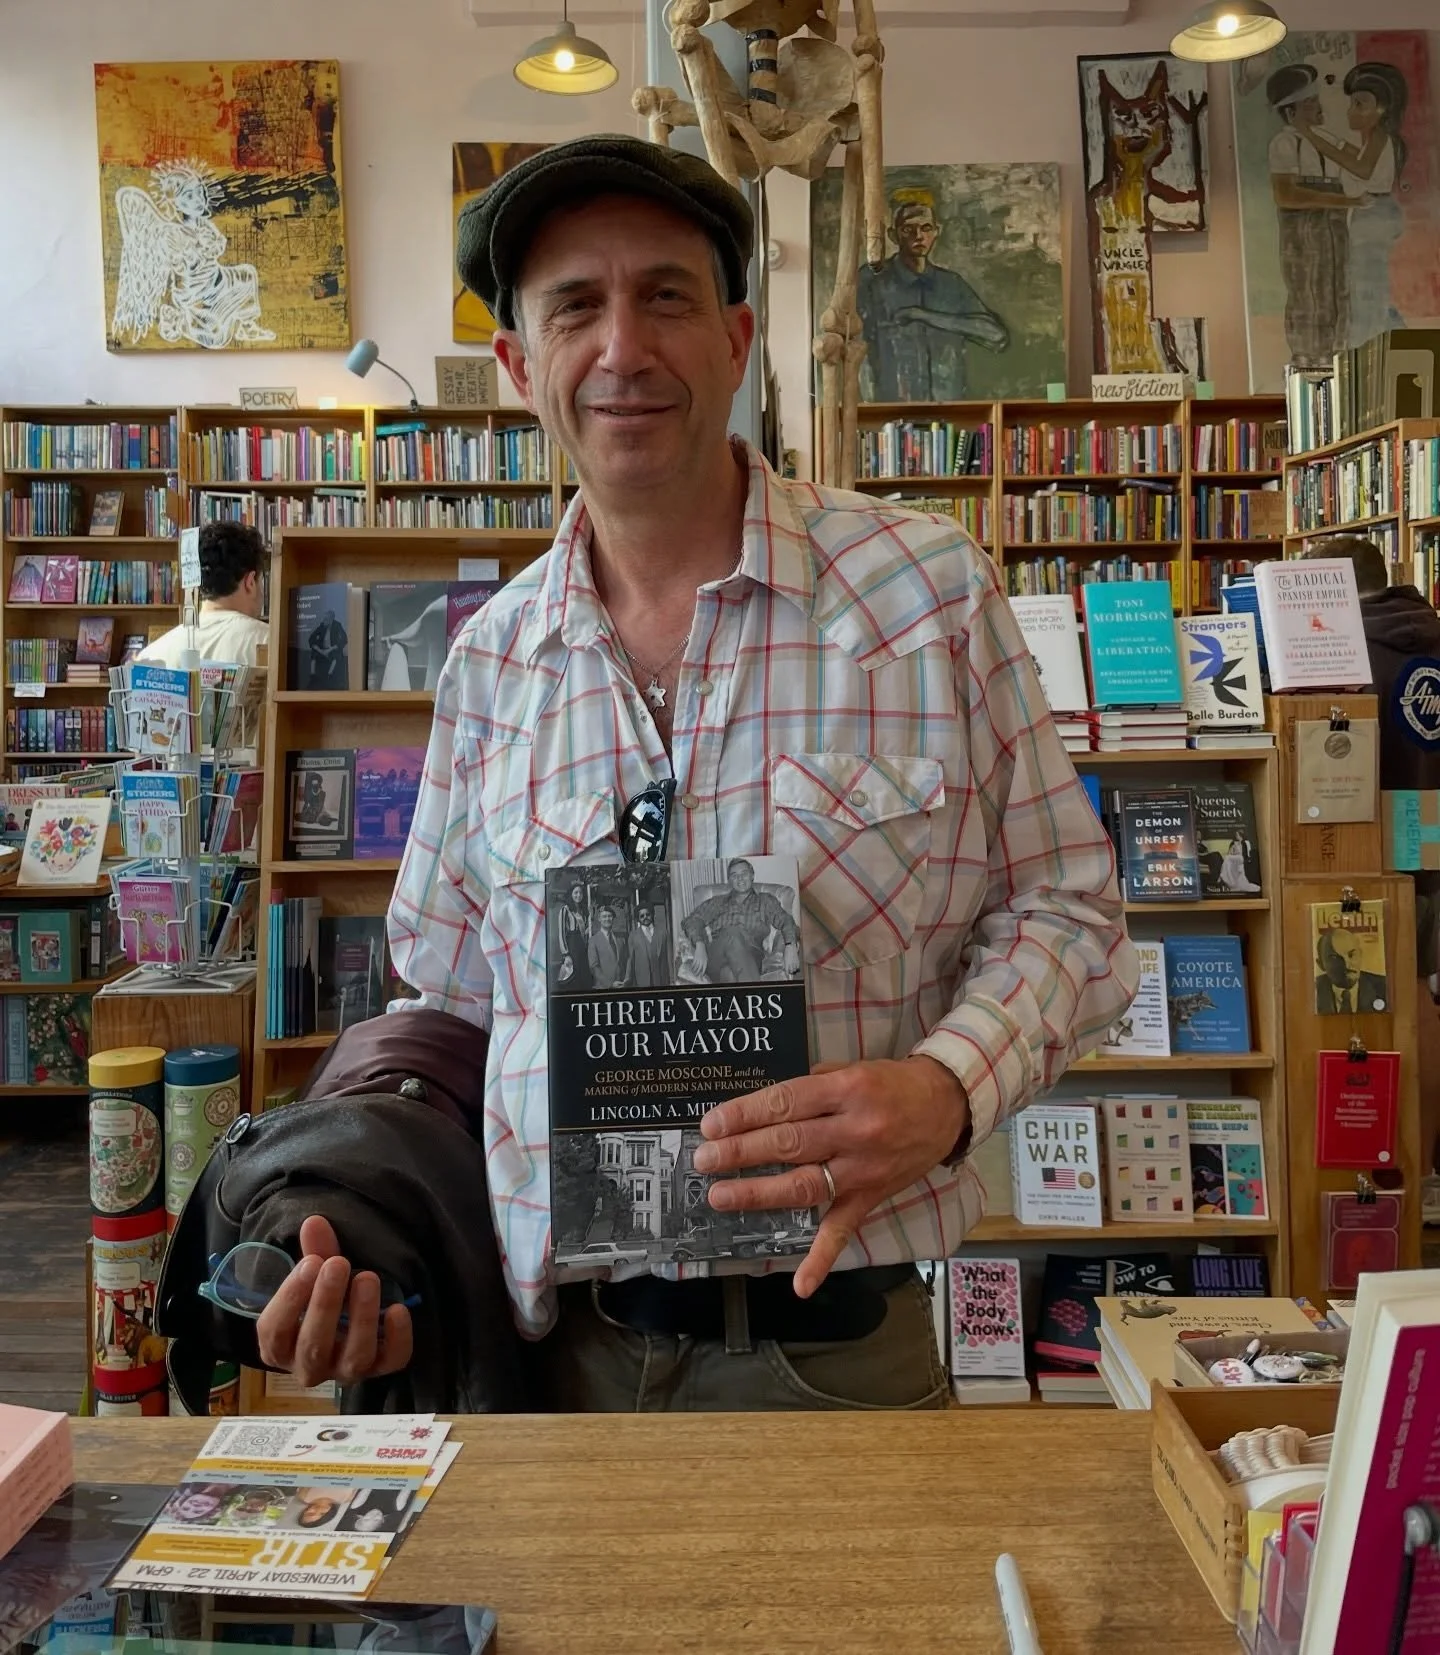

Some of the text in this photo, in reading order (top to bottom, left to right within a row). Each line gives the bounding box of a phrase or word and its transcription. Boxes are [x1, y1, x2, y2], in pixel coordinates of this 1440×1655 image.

[1104, 248, 1143, 259] UNCLE
[466, 360, 477, 404] CREATIVE
[242, 391, 296, 406] POETRY
[1294, 572, 1346, 586] RADICAL
[1278, 589, 1348, 600] SPANISH EMPIRE
[1115, 600, 1144, 608] TONI
[1094, 611, 1168, 622] MORRISON
[1181, 620, 1247, 632] Strangers
[1097, 646, 1172, 656] LIBERATION
[136, 679, 184, 692] STICKERS
[1186, 708, 1258, 720] Belle Burden
[8, 788, 44, 797] DRESS
[128, 808, 177, 817] RTHDAY!
[1200, 806, 1242, 818] Society
[1136, 818, 1182, 828] DEMON
[1136, 835, 1184, 845] UNREST
[1148, 864, 1176, 872] ERIK
[1134, 876, 1193, 888] LARSON
[1316, 908, 1378, 929] Lenin
[1176, 962, 1234, 972] COYOTE
[1172, 976, 1242, 988] AMERICA
[571, 993, 784, 1028] THREE YEARS
[586, 1026, 774, 1059] OUR MAYOR
[594, 1065, 766, 1084] GEORGE MOSCONE and the
[584, 1079, 776, 1097] MAKING of MODERN SAN FRANCISCO
[590, 1104, 662, 1121] LINCOLN
[666, 1104, 681, 1118] A.
[1025, 1120, 1088, 1140] CHIP
[1028, 1144, 1088, 1164] WAR
[961, 1266, 1006, 1282] What
[1115, 1272, 1136, 1285] OW
[1140, 1264, 1156, 1277] TO
[1192, 1258, 1264, 1288] LONG LIVE
[972, 1285, 998, 1300] the
[966, 1302, 1006, 1322] Body
[961, 1320, 1014, 1336] Knows
[252, 1538, 374, 1570] STIR
[136, 1564, 356, 1585] WEDNESDAY APRIL 22 6PM
